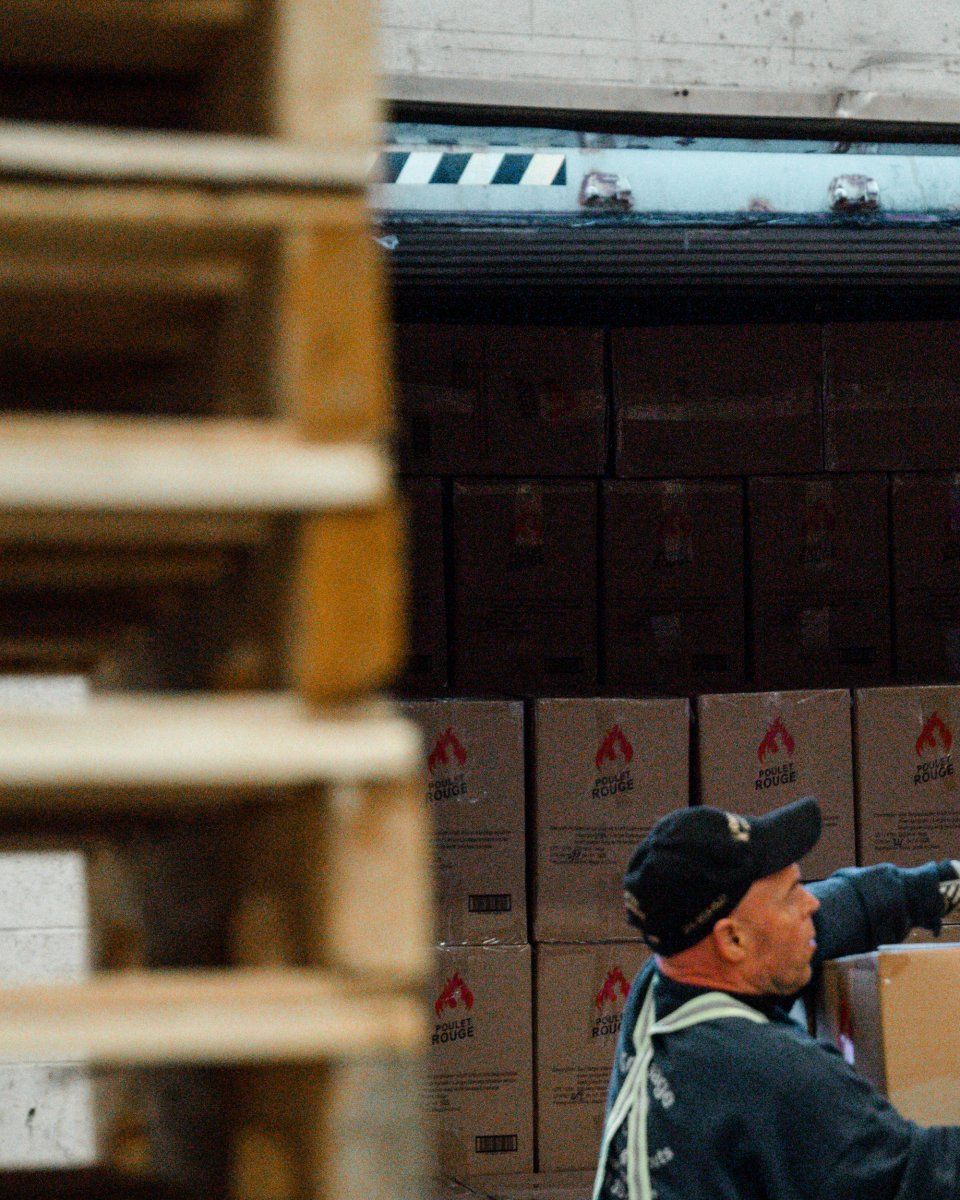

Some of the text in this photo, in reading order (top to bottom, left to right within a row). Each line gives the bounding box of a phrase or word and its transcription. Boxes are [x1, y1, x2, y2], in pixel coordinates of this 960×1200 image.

[755, 771, 796, 790] ROUGE
[914, 764, 953, 785] ROUGE
[592, 779, 633, 799] ROUGE
[431, 1027, 473, 1045] ROUGE
